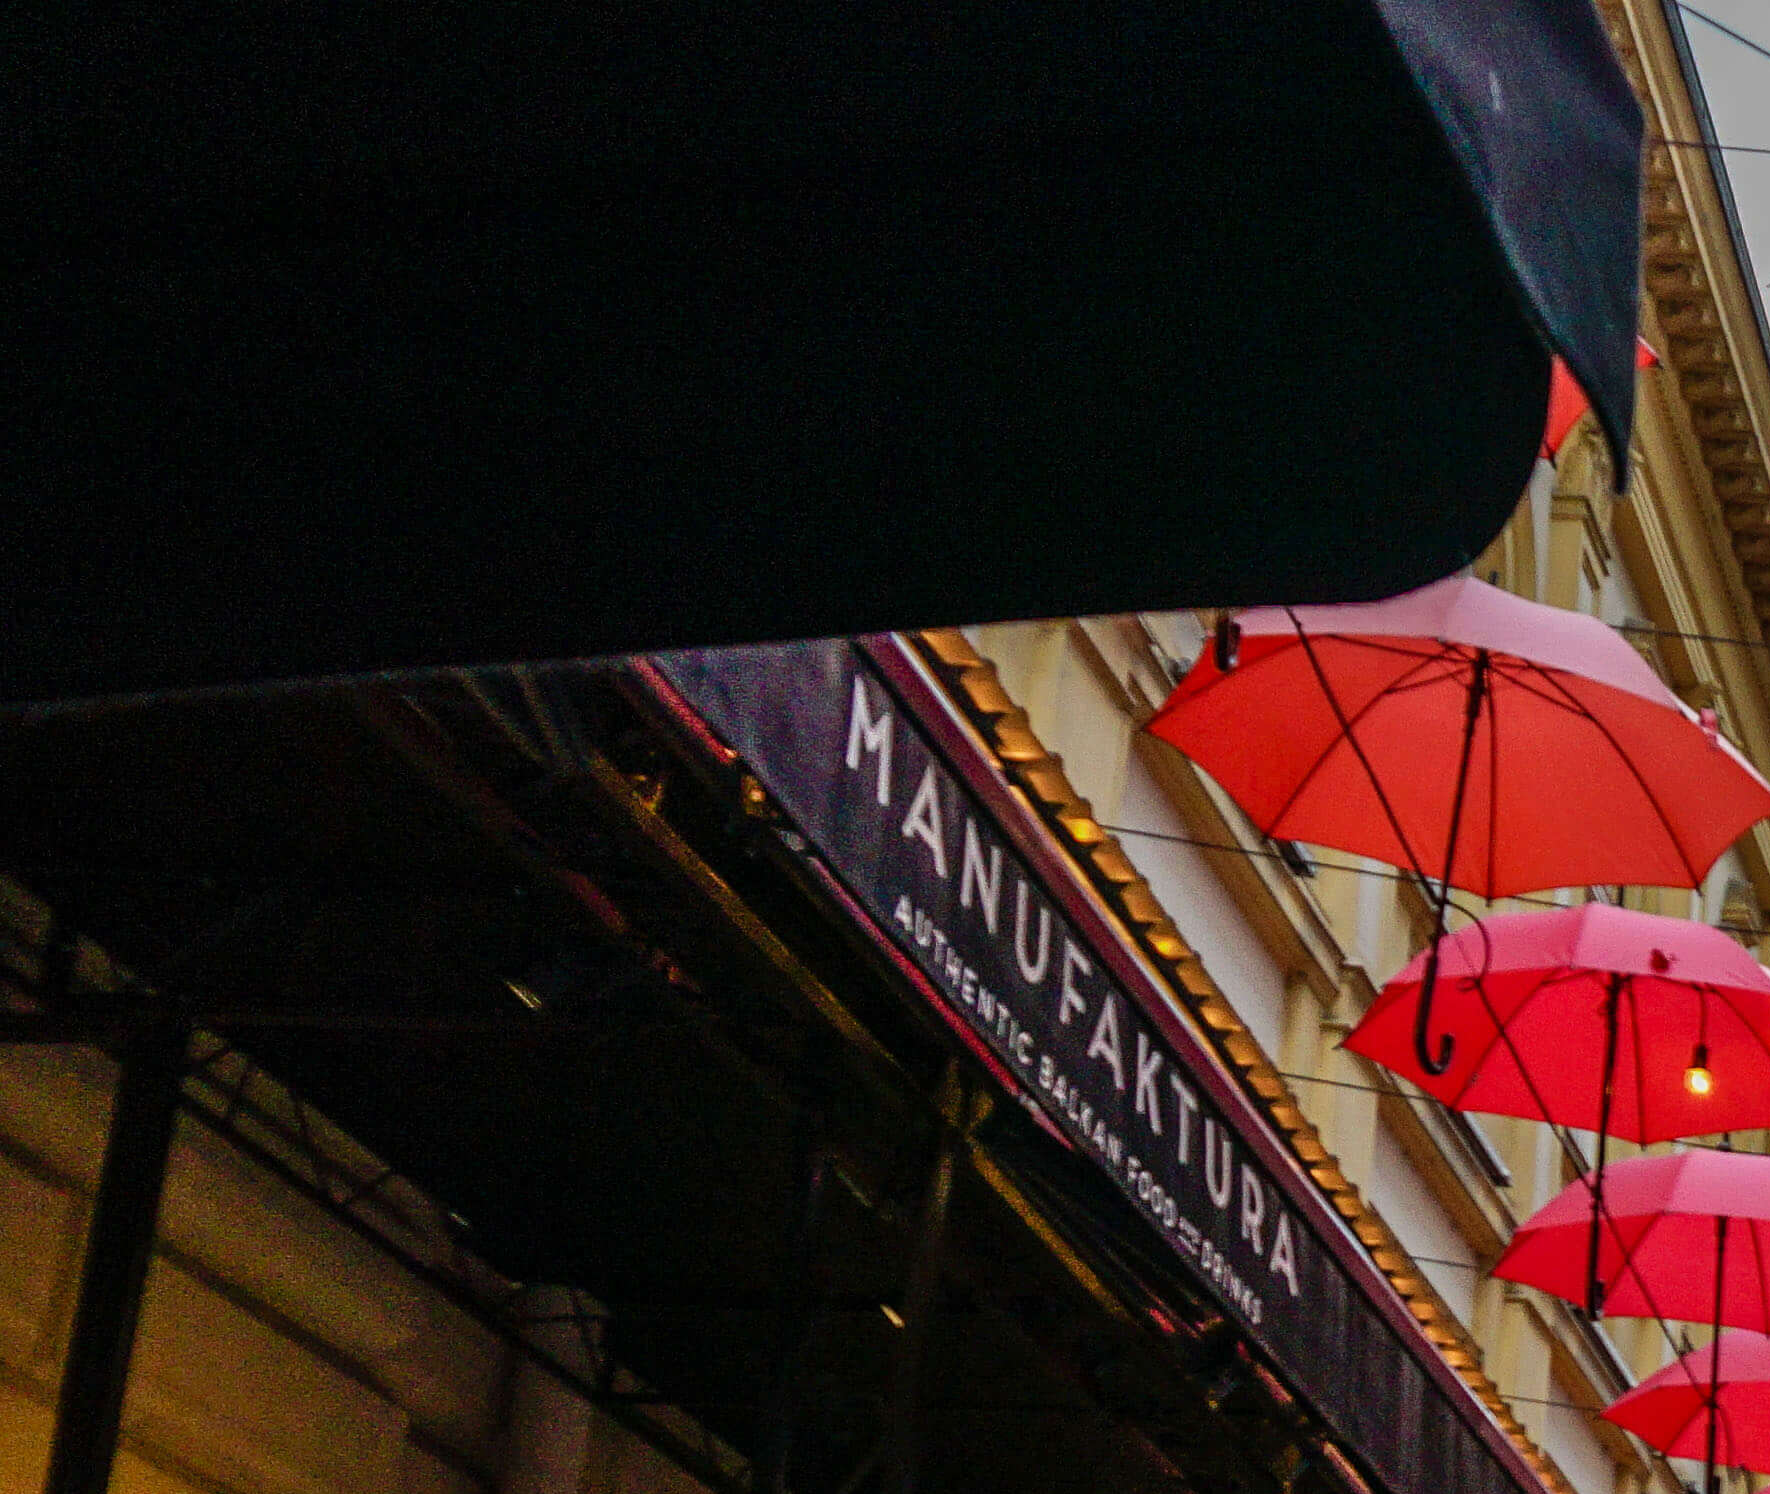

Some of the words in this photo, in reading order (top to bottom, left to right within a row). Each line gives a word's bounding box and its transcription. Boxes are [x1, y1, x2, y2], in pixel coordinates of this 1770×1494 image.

[846, 674, 1299, 1297] MANUFAKTURA
[894, 894, 1034, 1066] AUTHENTIC
[1039, 1055, 1122, 1165] BALKAN
[1127, 1156, 1178, 1228] FOOD
[1201, 1240, 1262, 1325] DRINKS
